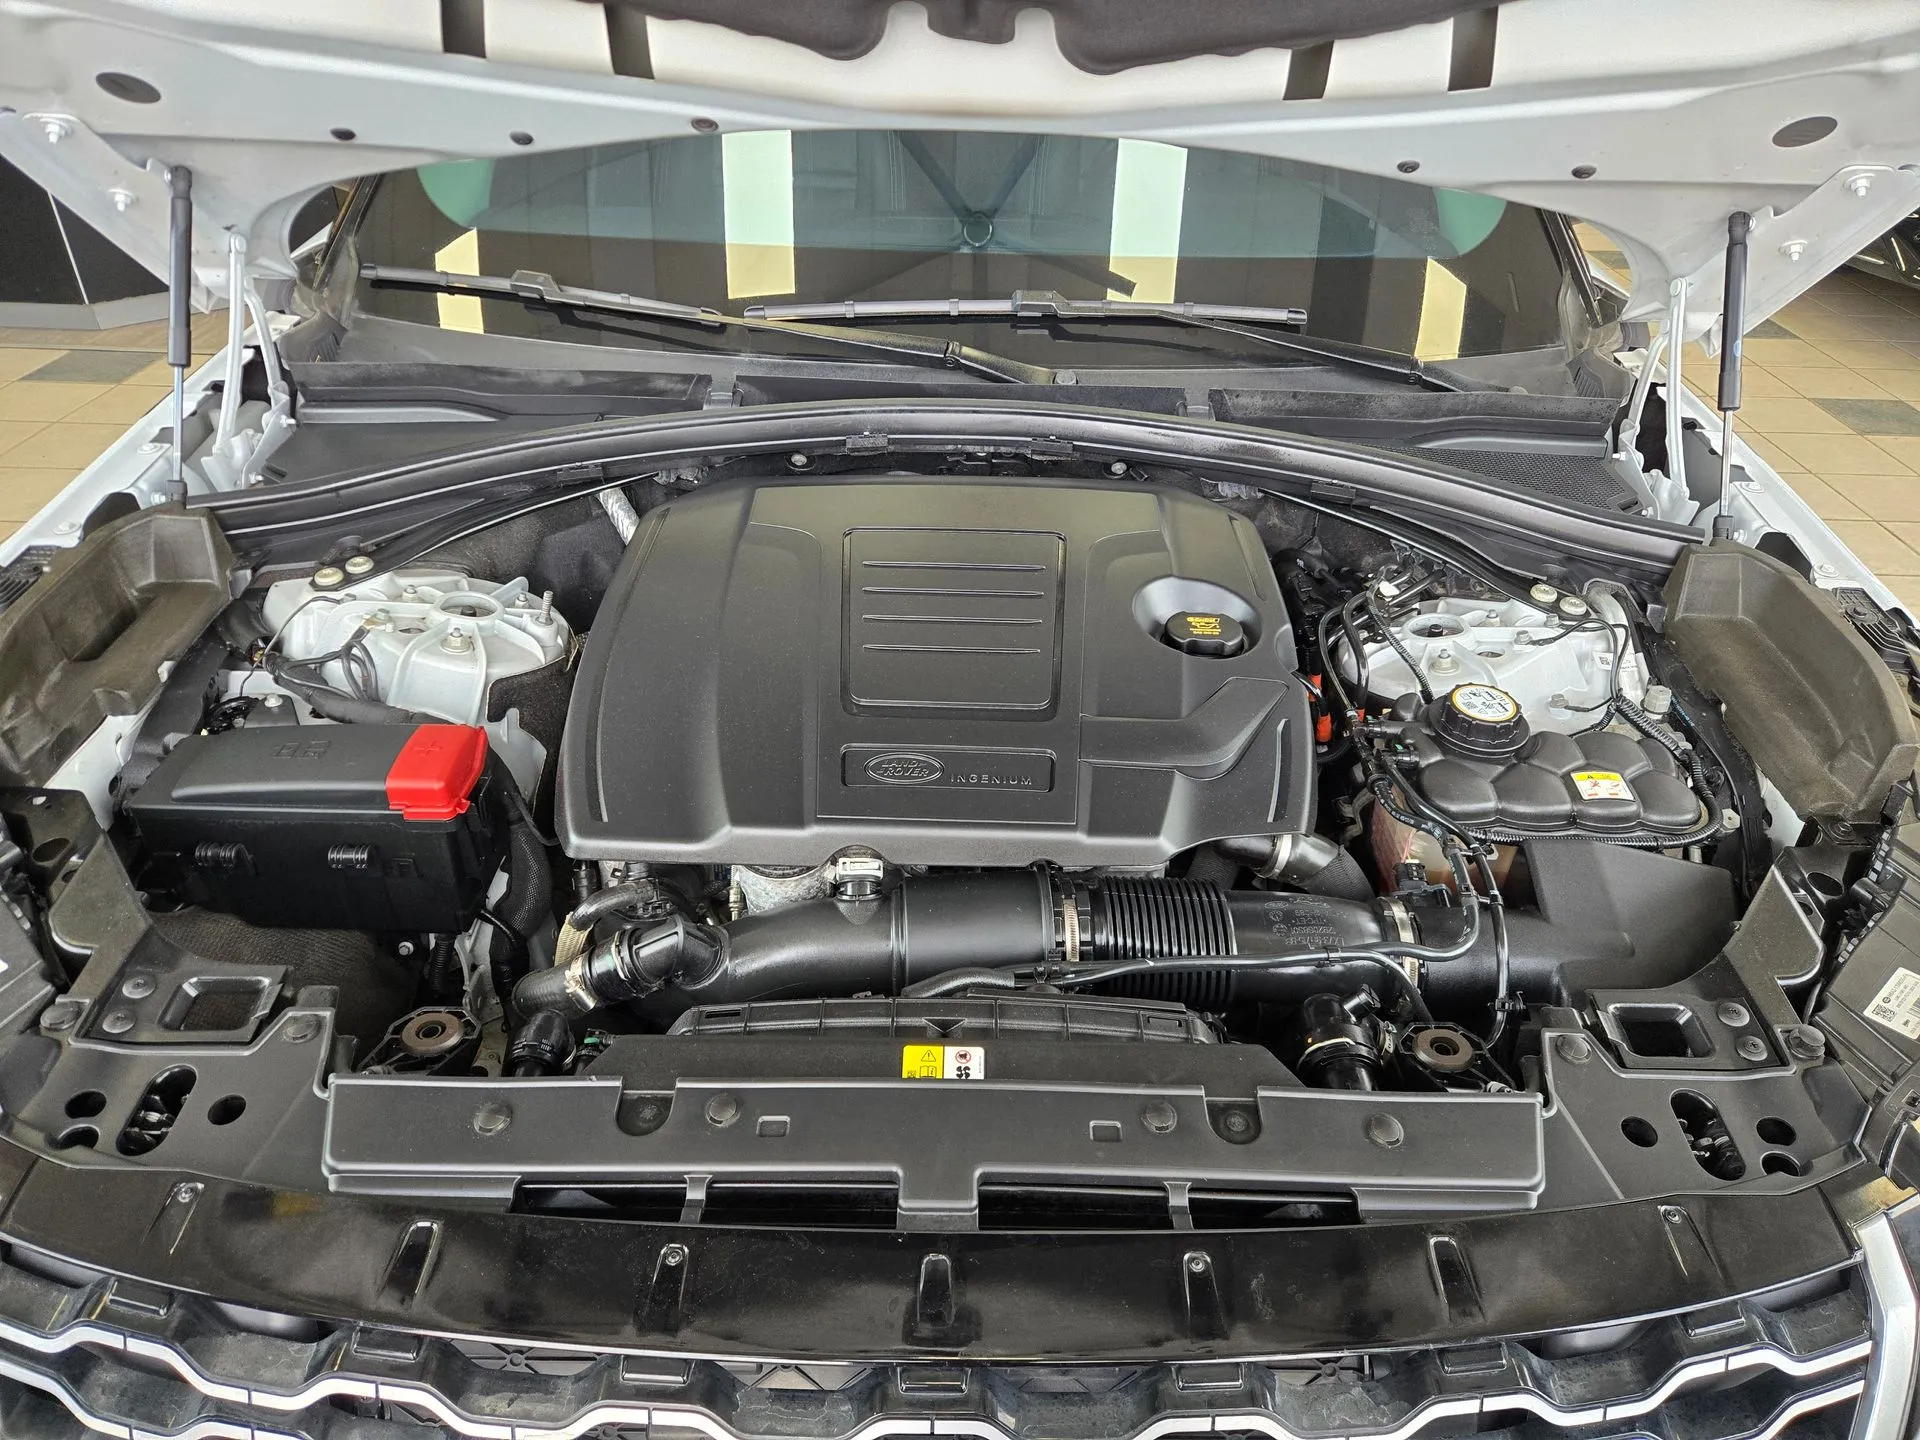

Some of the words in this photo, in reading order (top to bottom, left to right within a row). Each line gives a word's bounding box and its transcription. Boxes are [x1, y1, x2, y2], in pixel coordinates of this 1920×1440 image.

[881, 760, 919, 768] LAND
[883, 768, 929, 777] ROVER
[950, 773, 1032, 786] INGENIUM
